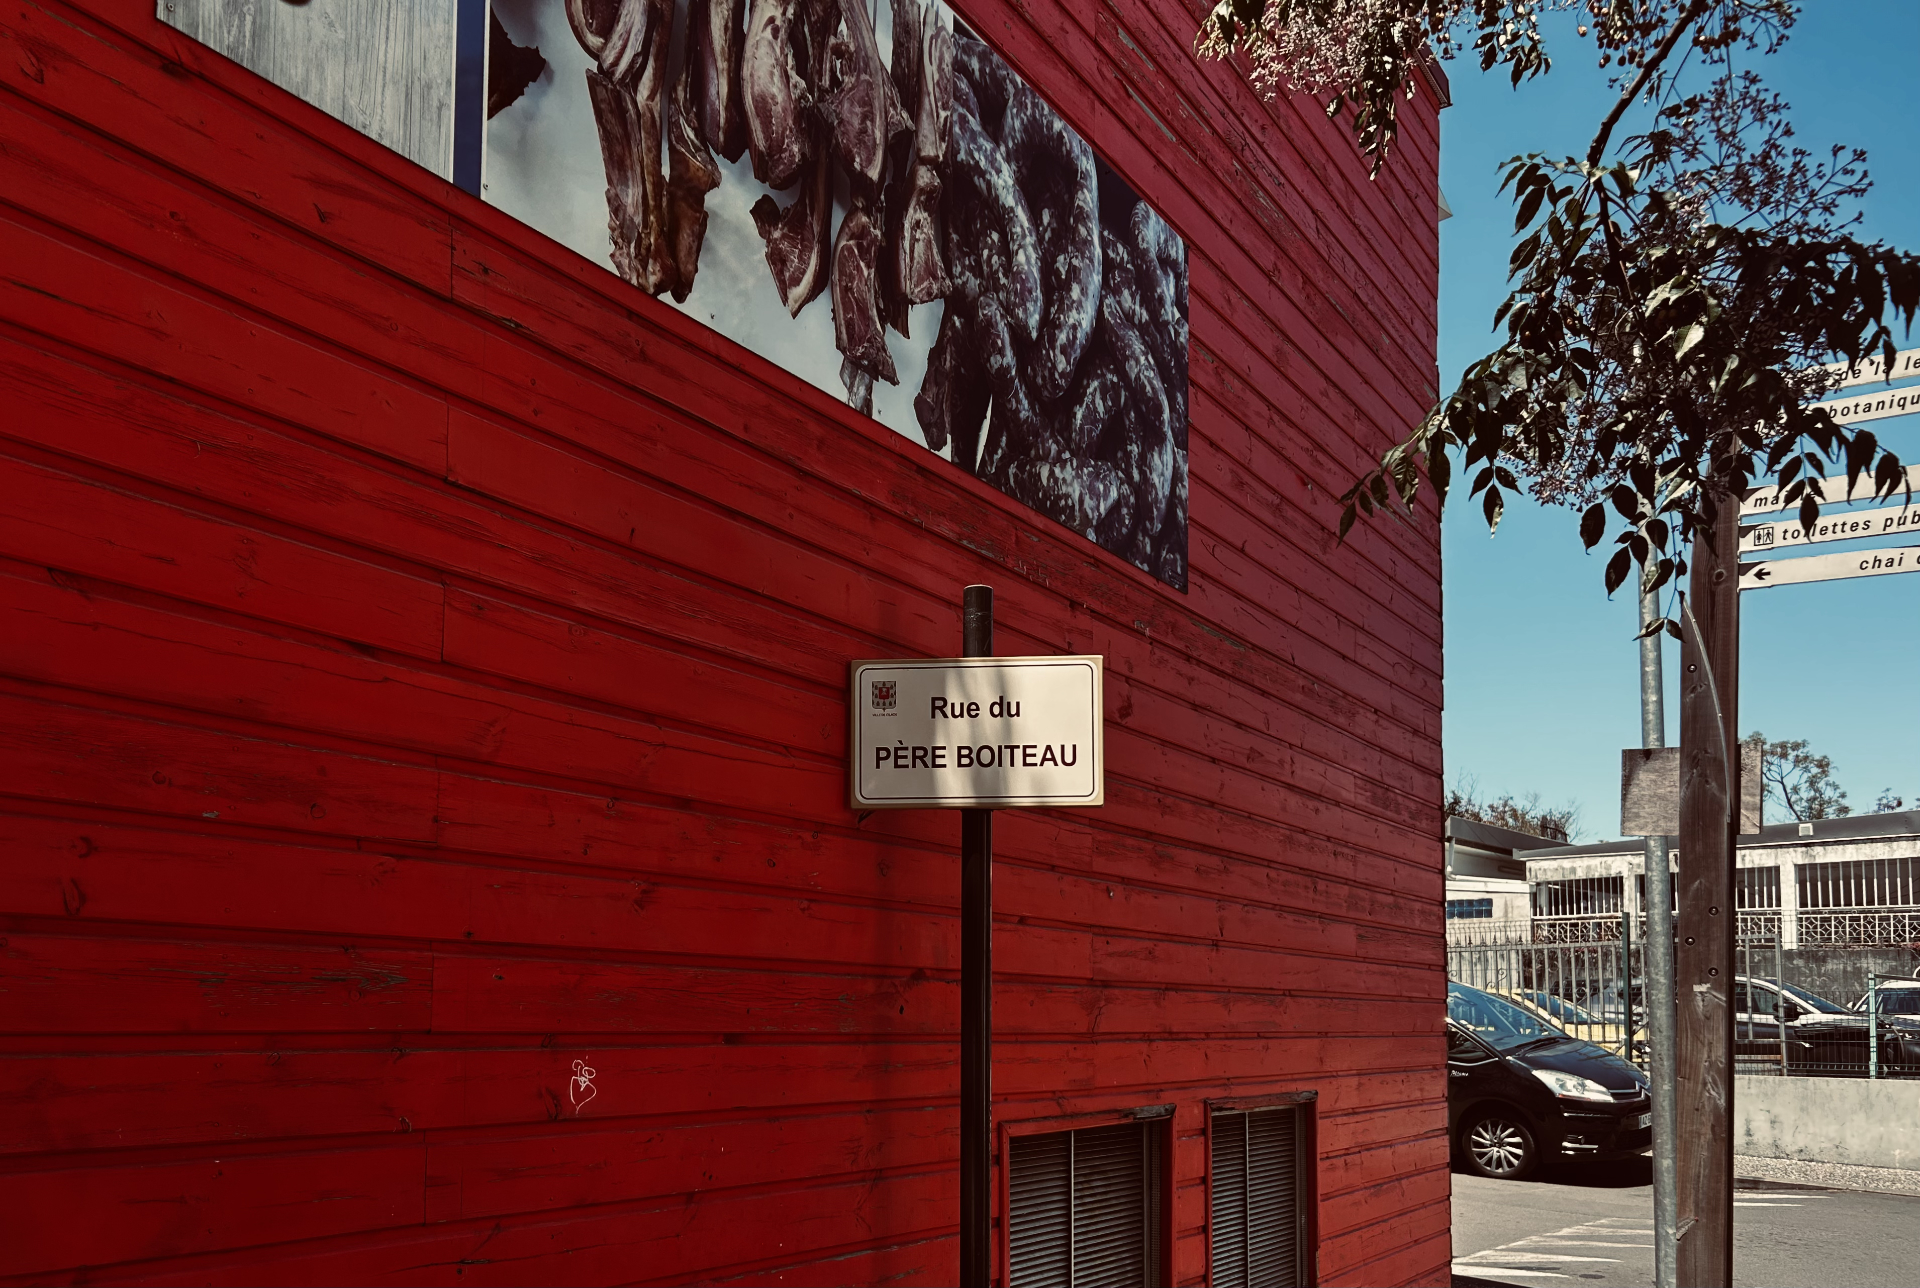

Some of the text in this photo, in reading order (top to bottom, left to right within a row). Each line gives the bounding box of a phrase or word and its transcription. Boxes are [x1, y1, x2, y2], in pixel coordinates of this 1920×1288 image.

[1828, 394, 1920, 419] botaniqu
[1782, 519, 1872, 541] tolettes
[1859, 553, 1905, 571] chai
[930, 696, 1021, 720] Rue du
[875, 740, 1077, 769] PÈRE BOITEAU
